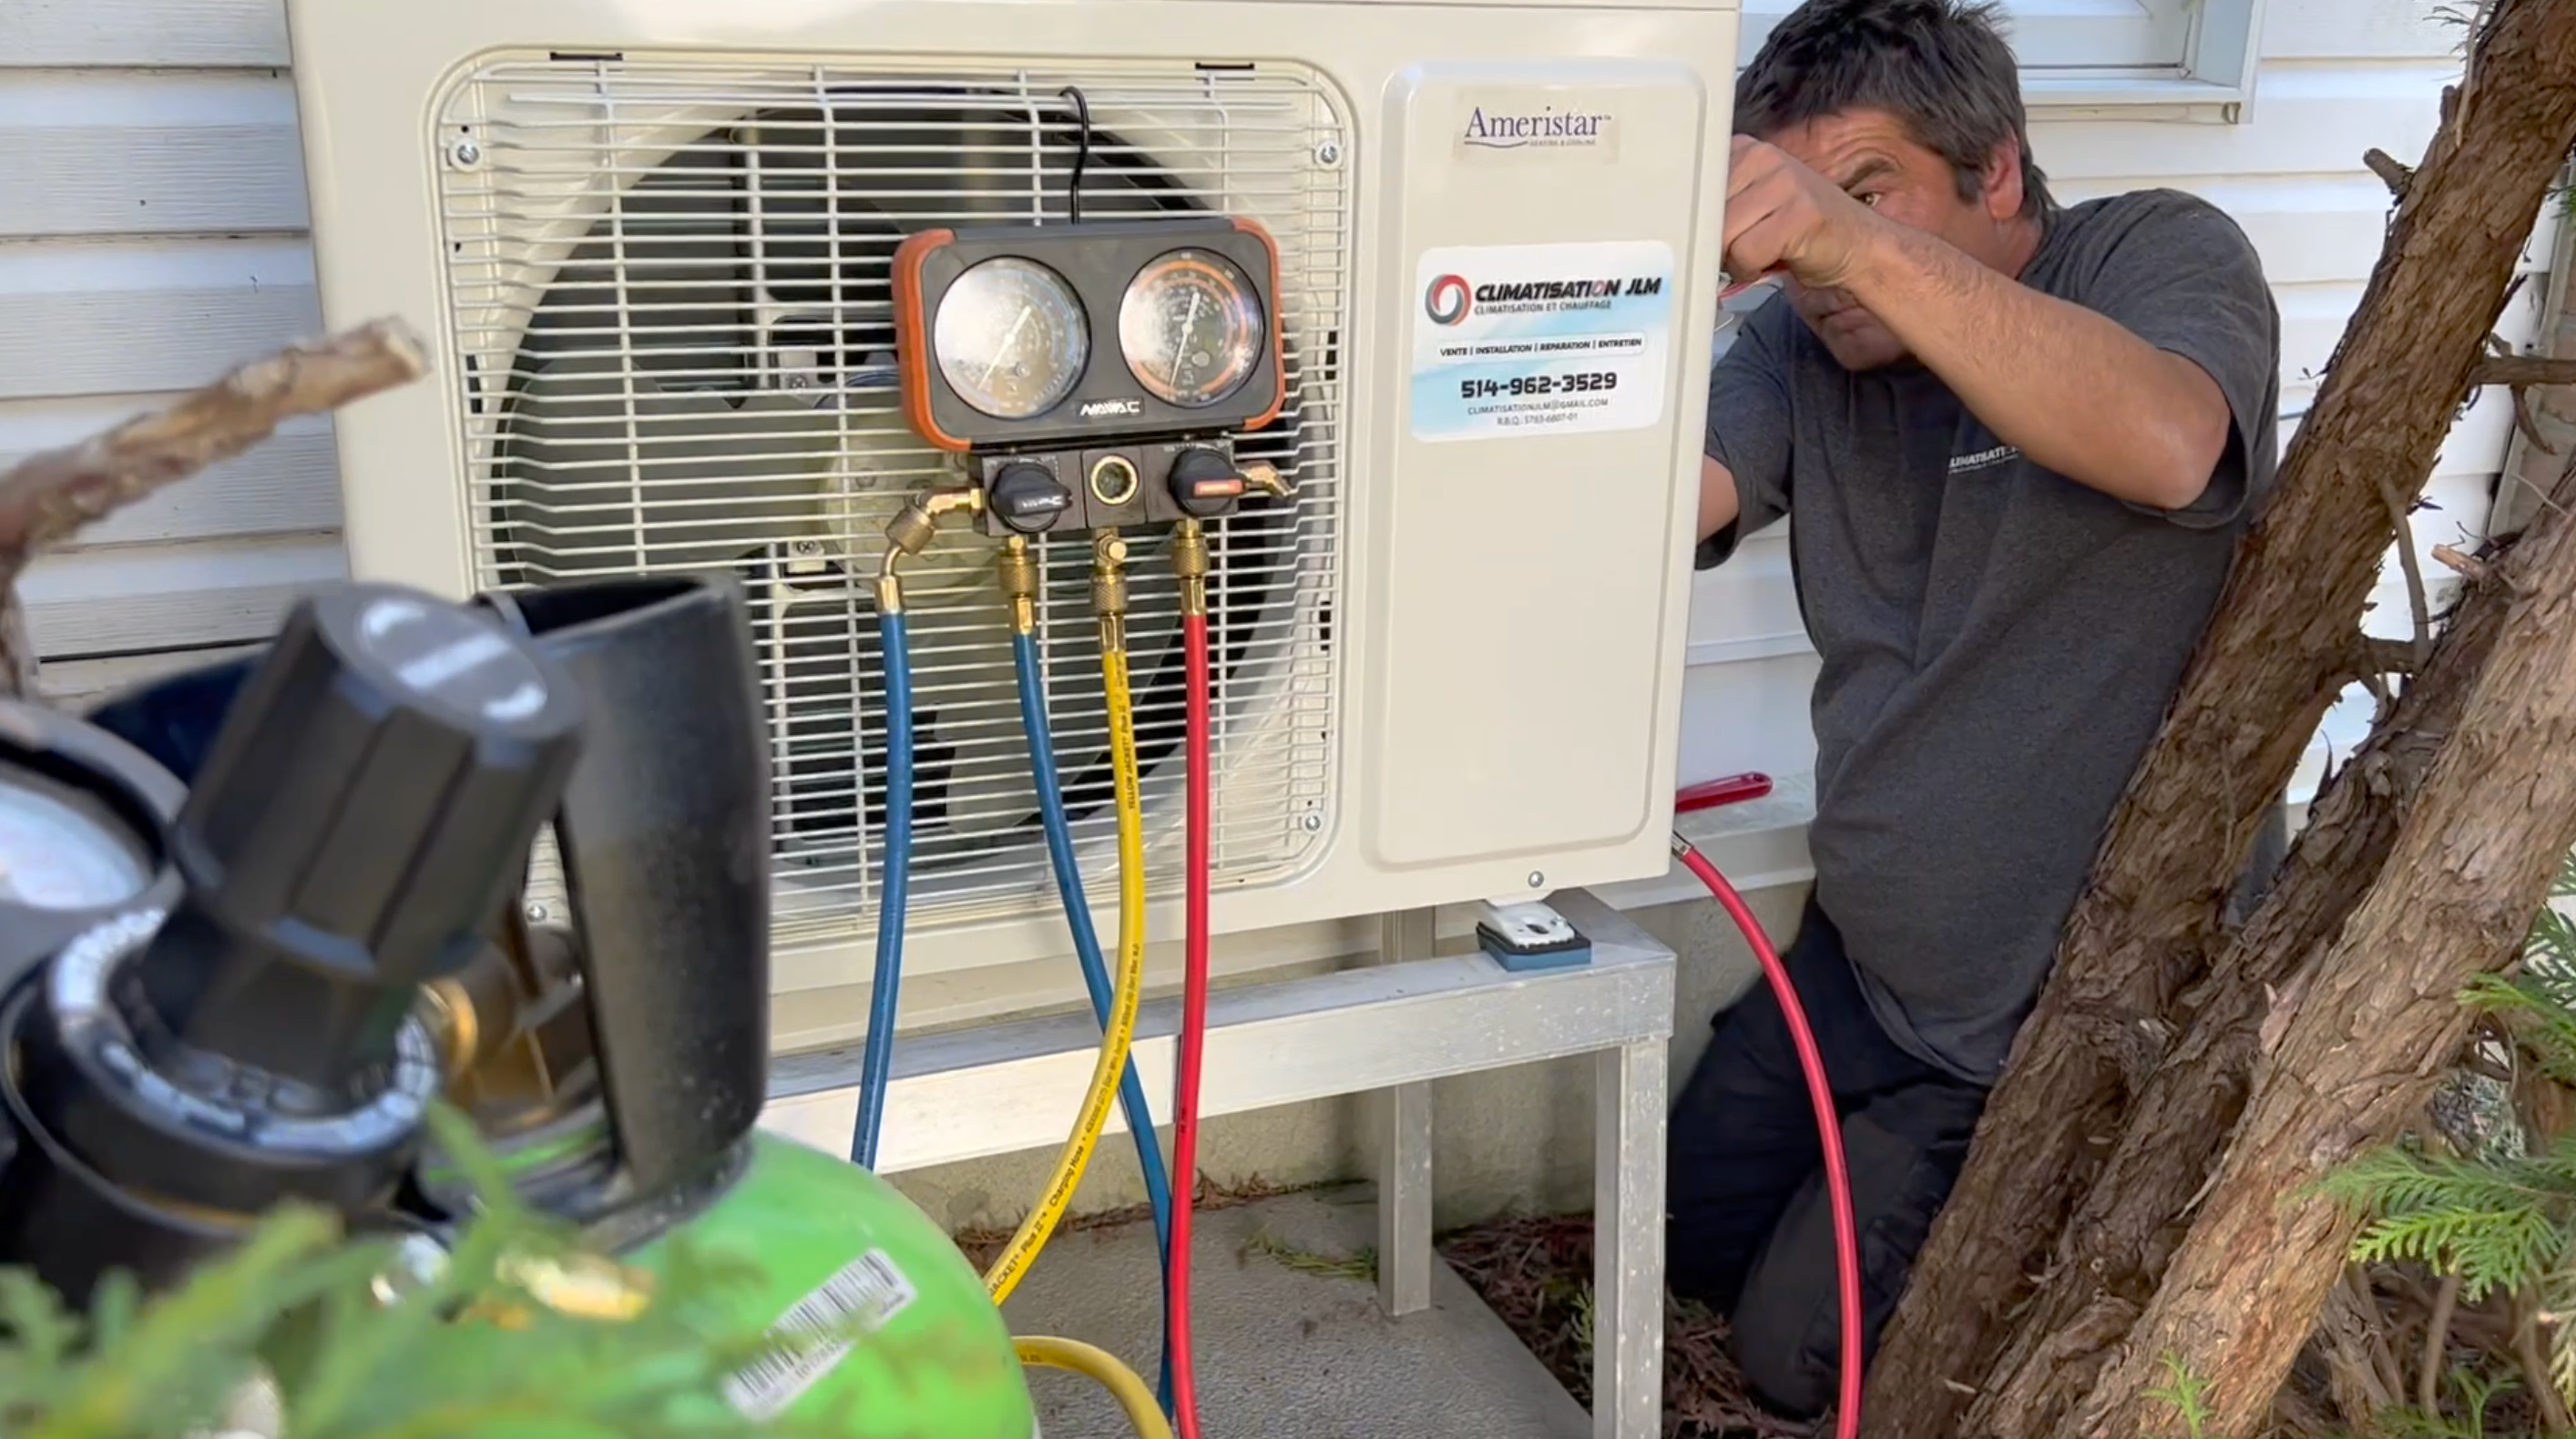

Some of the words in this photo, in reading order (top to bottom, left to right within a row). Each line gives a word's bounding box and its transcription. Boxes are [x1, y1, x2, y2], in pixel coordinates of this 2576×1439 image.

[1475, 280, 1620, 301] CLIMATISATION
[1625, 277, 1662, 296] JLM
[1474, 302, 1543, 315] CLIMATISATION
[1546, 301, 1558, 311] ET
[1559, 300, 1611, 311] CHAUFFAGE
[1440, 347, 1467, 356] VENTE
[1476, 343, 1532, 354] INSTALLATION
[1598, 338, 1641, 349] ENTRETIEN
[1461, 373, 1617, 398] 514-962-3529
[1080, 402, 1140, 416] NAVAC
[1020, 1232, 1038, 1253] Plus
[1048, 1167, 1075, 1207] Charging
[1069, 1145, 1085, 1168] Hose
